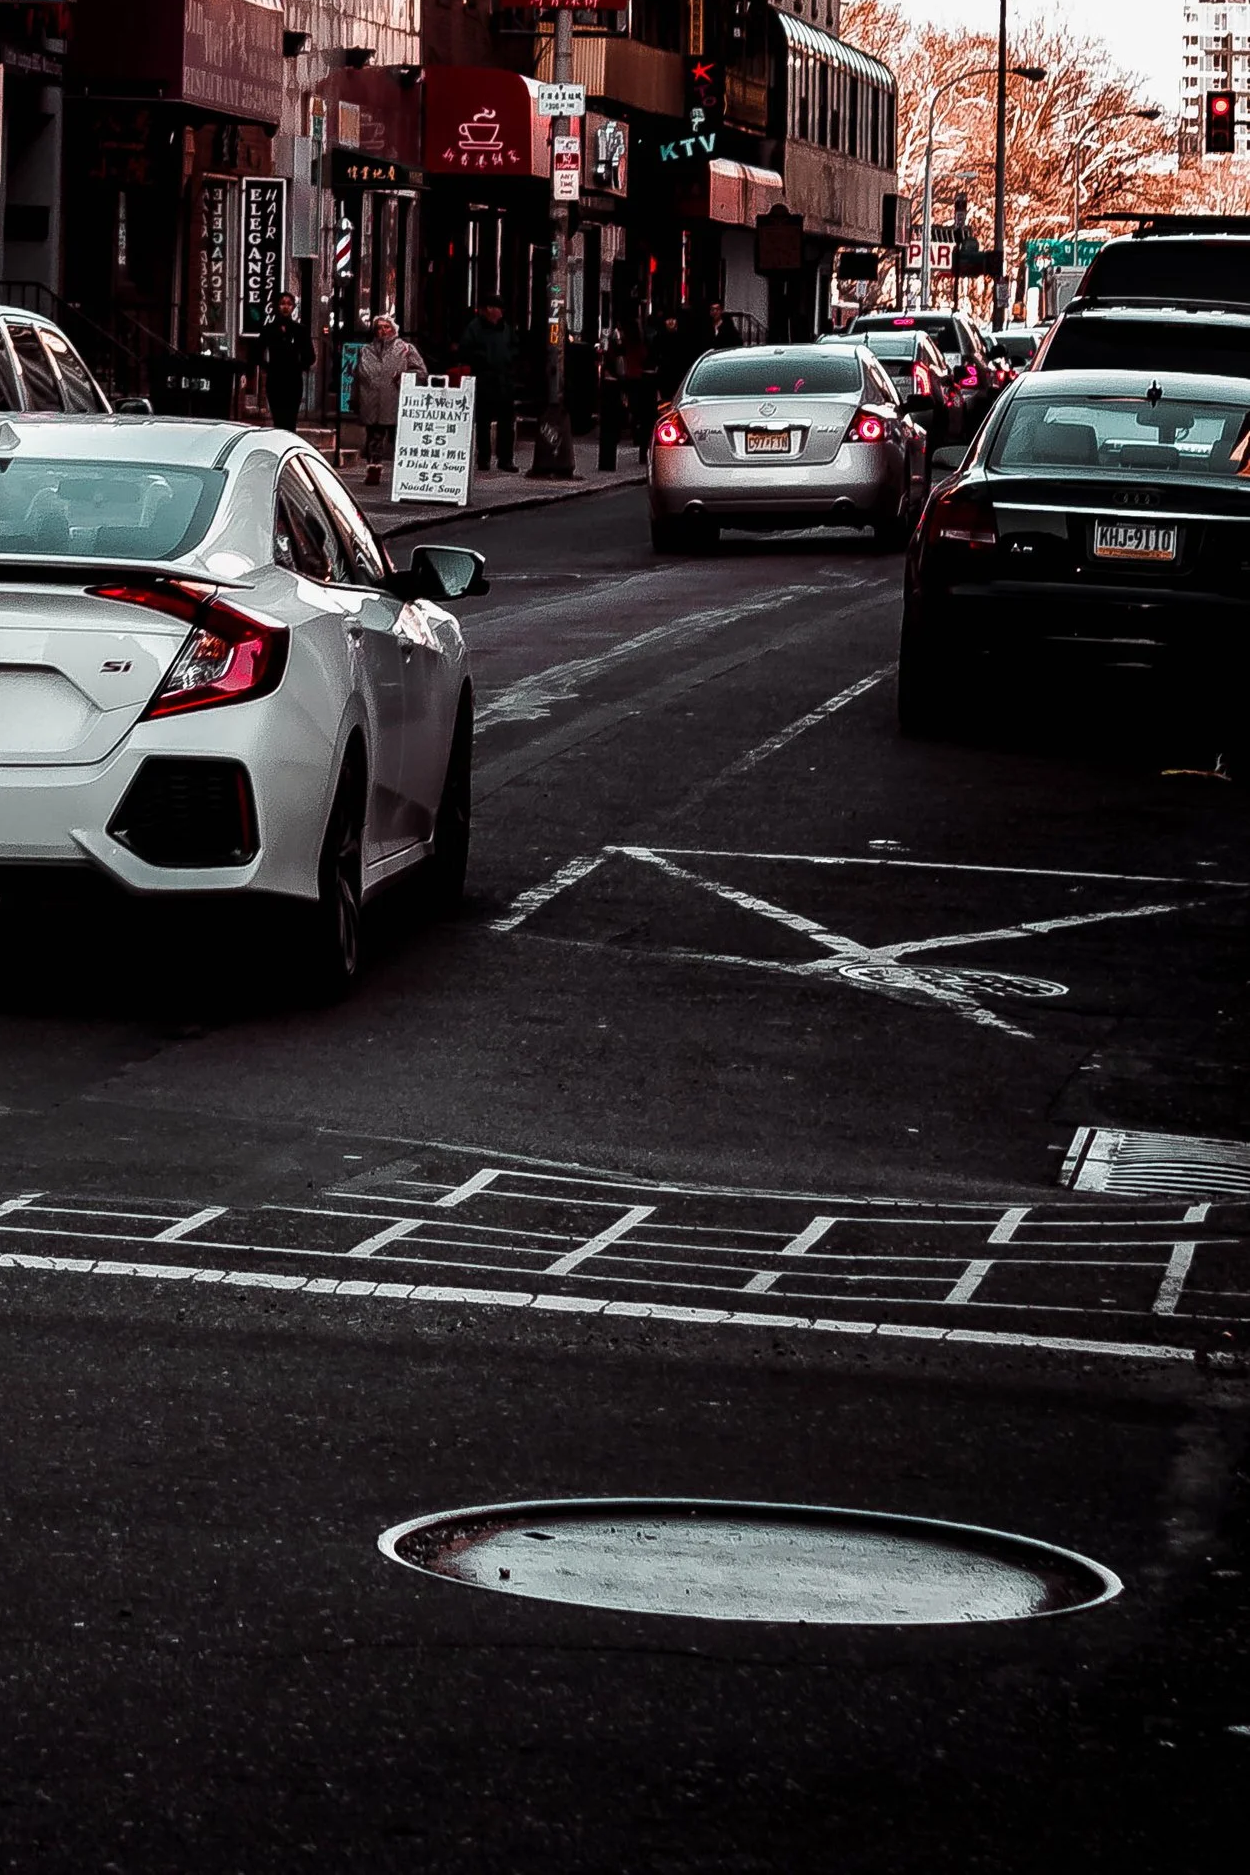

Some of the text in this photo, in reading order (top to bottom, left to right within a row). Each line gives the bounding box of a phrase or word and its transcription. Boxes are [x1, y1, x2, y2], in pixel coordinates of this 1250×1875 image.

[659, 132, 717, 162] KTV
[248, 188, 262, 303] ELEGANCE
[263, 188, 278, 326] HAIR DESIGN
[401, 409, 470, 422] RESTAURANT
[406, 460, 429, 469] Dish
[442, 463, 465, 473] Soup
[400, 482, 461, 496] Noodle Soup
